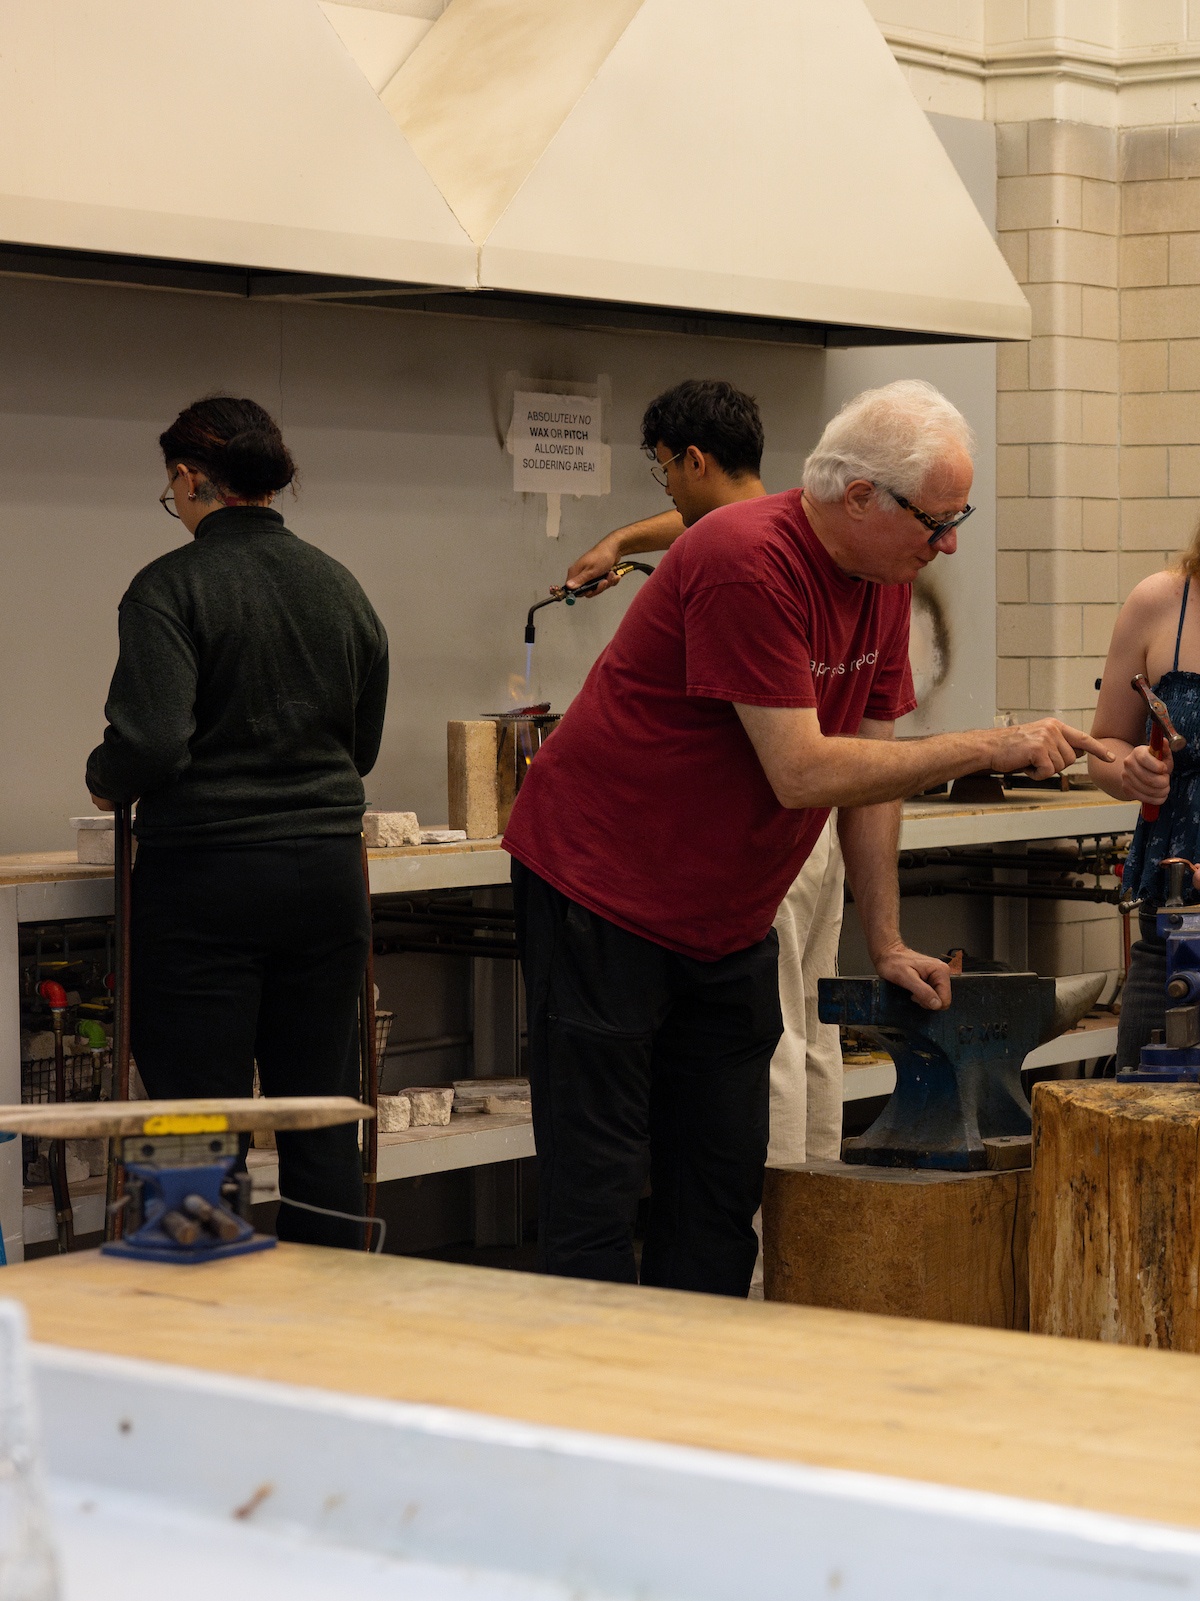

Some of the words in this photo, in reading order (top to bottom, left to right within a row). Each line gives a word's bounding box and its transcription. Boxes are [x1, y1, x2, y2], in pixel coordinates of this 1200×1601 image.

[527, 411, 577, 424] ABSOLUTELY
[579, 415, 592, 425] NO
[529, 427, 549, 438] WAX
[550, 428, 563, 439] OR
[564, 429, 588, 440] PITCH
[535, 443, 574, 455] ALLOWED
[575, 446, 584, 456] IN
[522, 458, 572, 471] SOLDERING
[573, 462, 595, 472] AREA!
